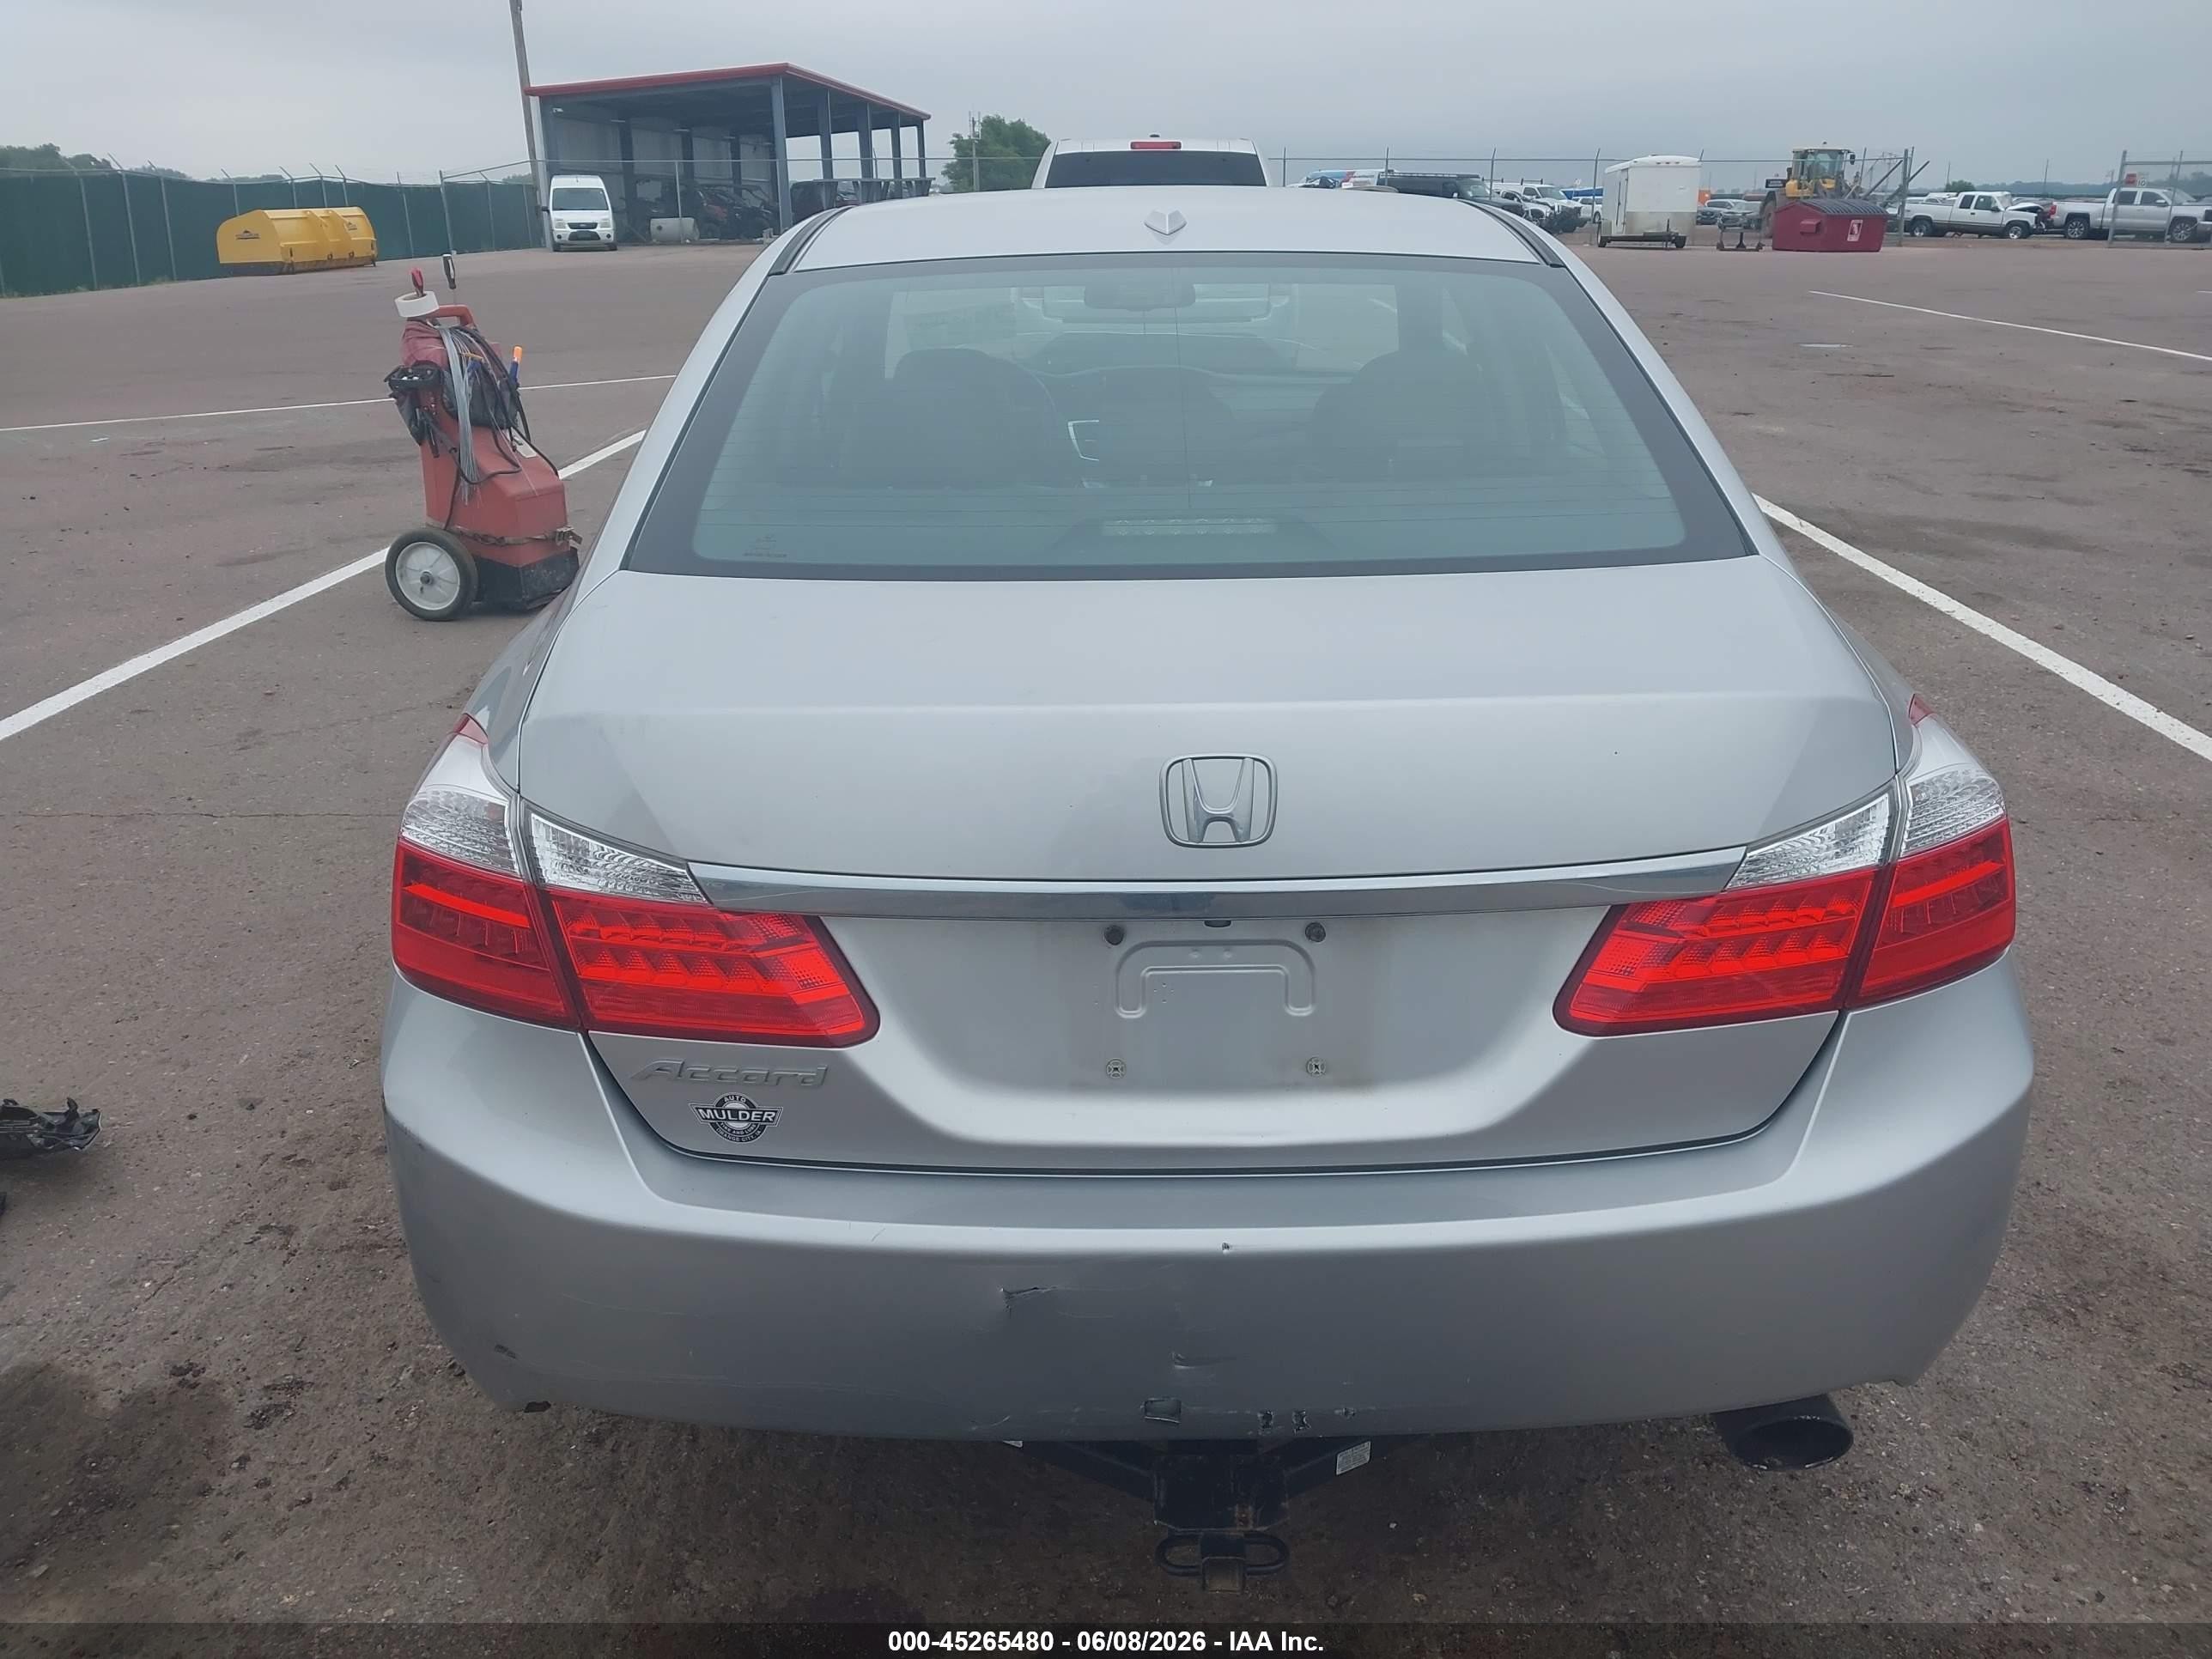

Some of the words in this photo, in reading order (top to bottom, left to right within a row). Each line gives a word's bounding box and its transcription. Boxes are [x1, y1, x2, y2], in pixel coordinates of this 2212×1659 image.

[631, 1058, 828, 1086] Accord
[697, 1109, 776, 1121] MULDER
[720, 1122, 732, 1132] TIRE
[716, 1127, 740, 1141] ORANGE
